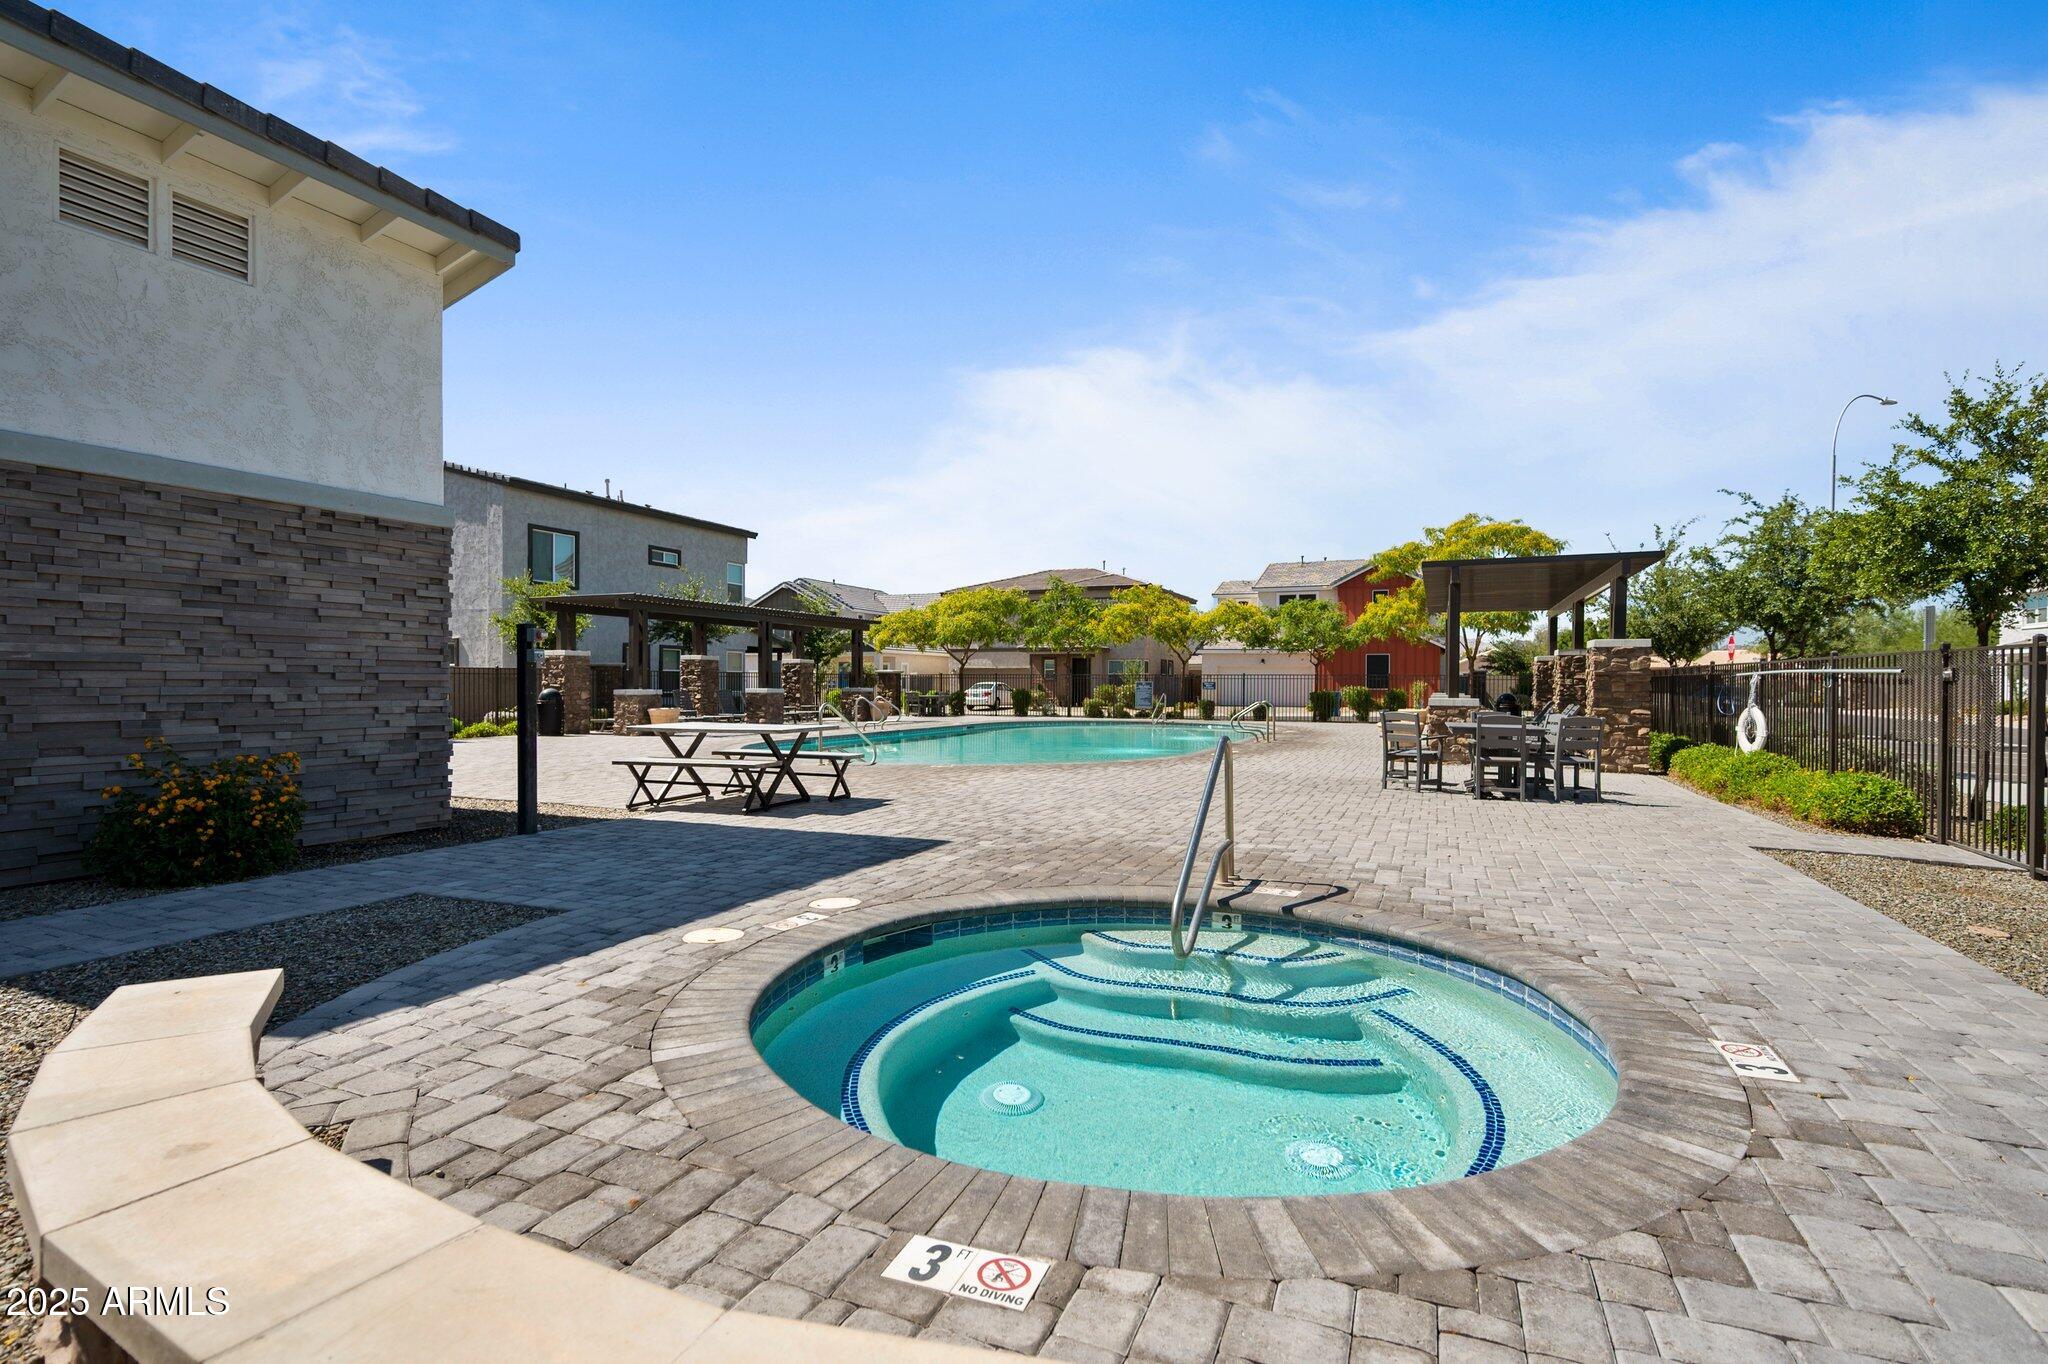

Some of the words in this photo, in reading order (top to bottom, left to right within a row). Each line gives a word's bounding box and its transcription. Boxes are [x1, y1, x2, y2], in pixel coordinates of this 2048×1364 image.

[830, 954, 839, 973] 3
[1735, 1063, 1789, 1075] 3
[908, 1244, 953, 1282] 3
[956, 1248, 973, 1260] FT
[959, 1283, 978, 1295] NO
[980, 1288, 1025, 1306] DIVING
